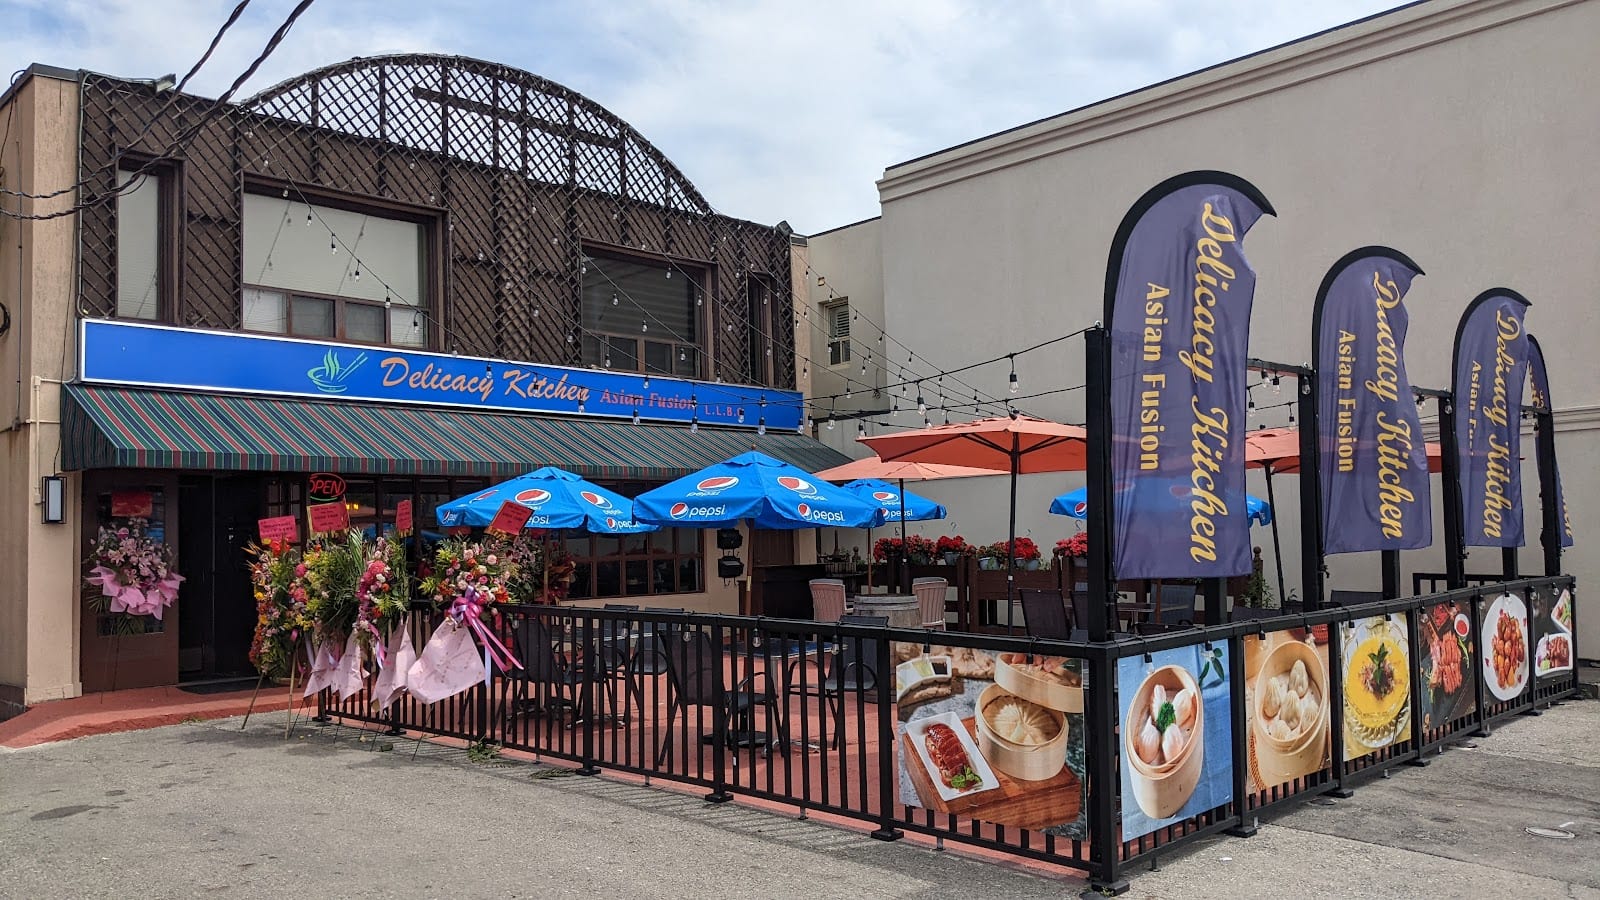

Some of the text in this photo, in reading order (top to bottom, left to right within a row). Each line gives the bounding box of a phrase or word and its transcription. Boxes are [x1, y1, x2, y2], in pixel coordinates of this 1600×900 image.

[380, 356, 495, 402] Delicacy
[503, 369, 590, 402] Kitchen
[600, 388, 644, 407] Asian
[1140, 282, 1170, 471] Asian Fusion
[1179, 201, 1237, 563] Delicacy Kitchen
[1337, 329, 1358, 472] Asian Fusion
[1468, 360, 1482, 411] Asian
[1375, 410, 1414, 540] Kitchen
[1483, 432, 1513, 538] Kitchen
[528, 515, 551, 525] psi
[688, 504, 726, 518] pepsi
[813, 509, 846, 523] pepsi
[890, 509, 912, 517] pesi
